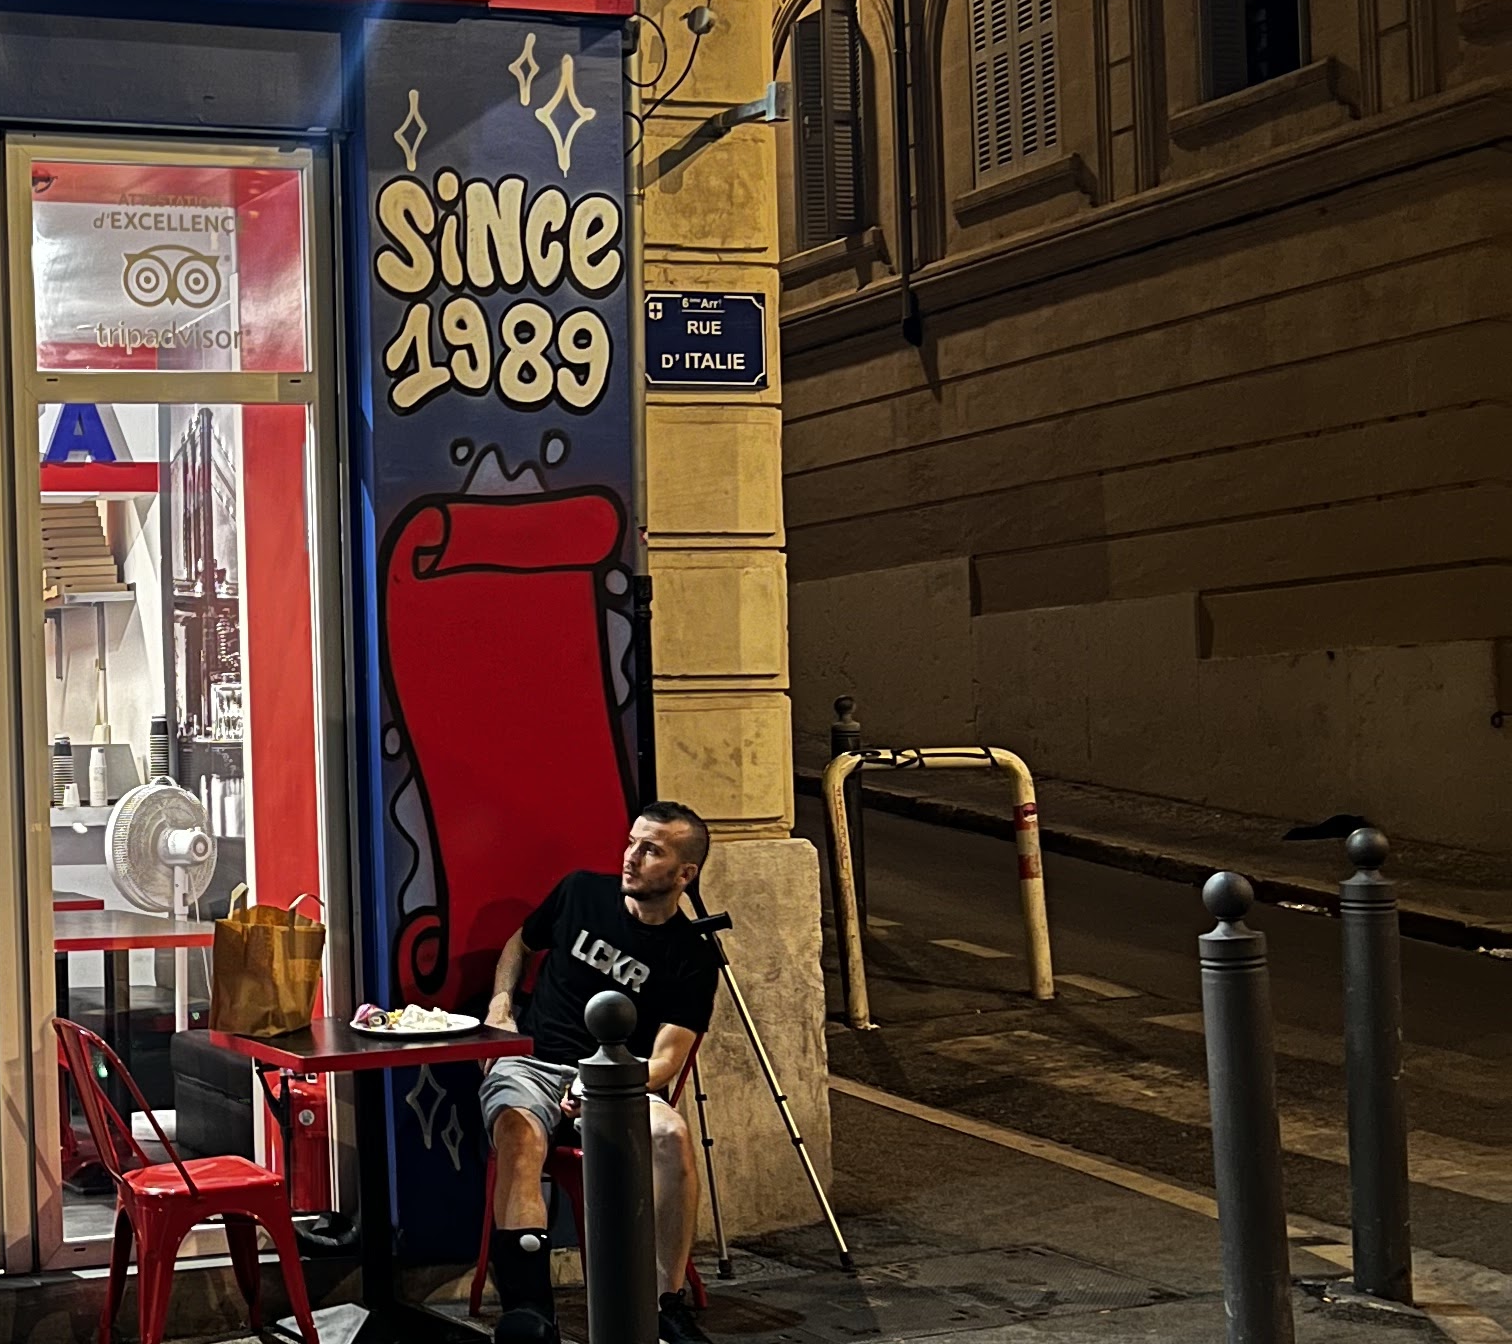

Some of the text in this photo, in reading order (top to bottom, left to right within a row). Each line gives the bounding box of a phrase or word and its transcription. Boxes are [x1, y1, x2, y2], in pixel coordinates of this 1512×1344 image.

[95, 320, 242, 354] tripadvisor
[687, 320, 722, 335] RUE
[385, 299, 610, 409] 1989
[571, 929, 651, 993] LCKR
